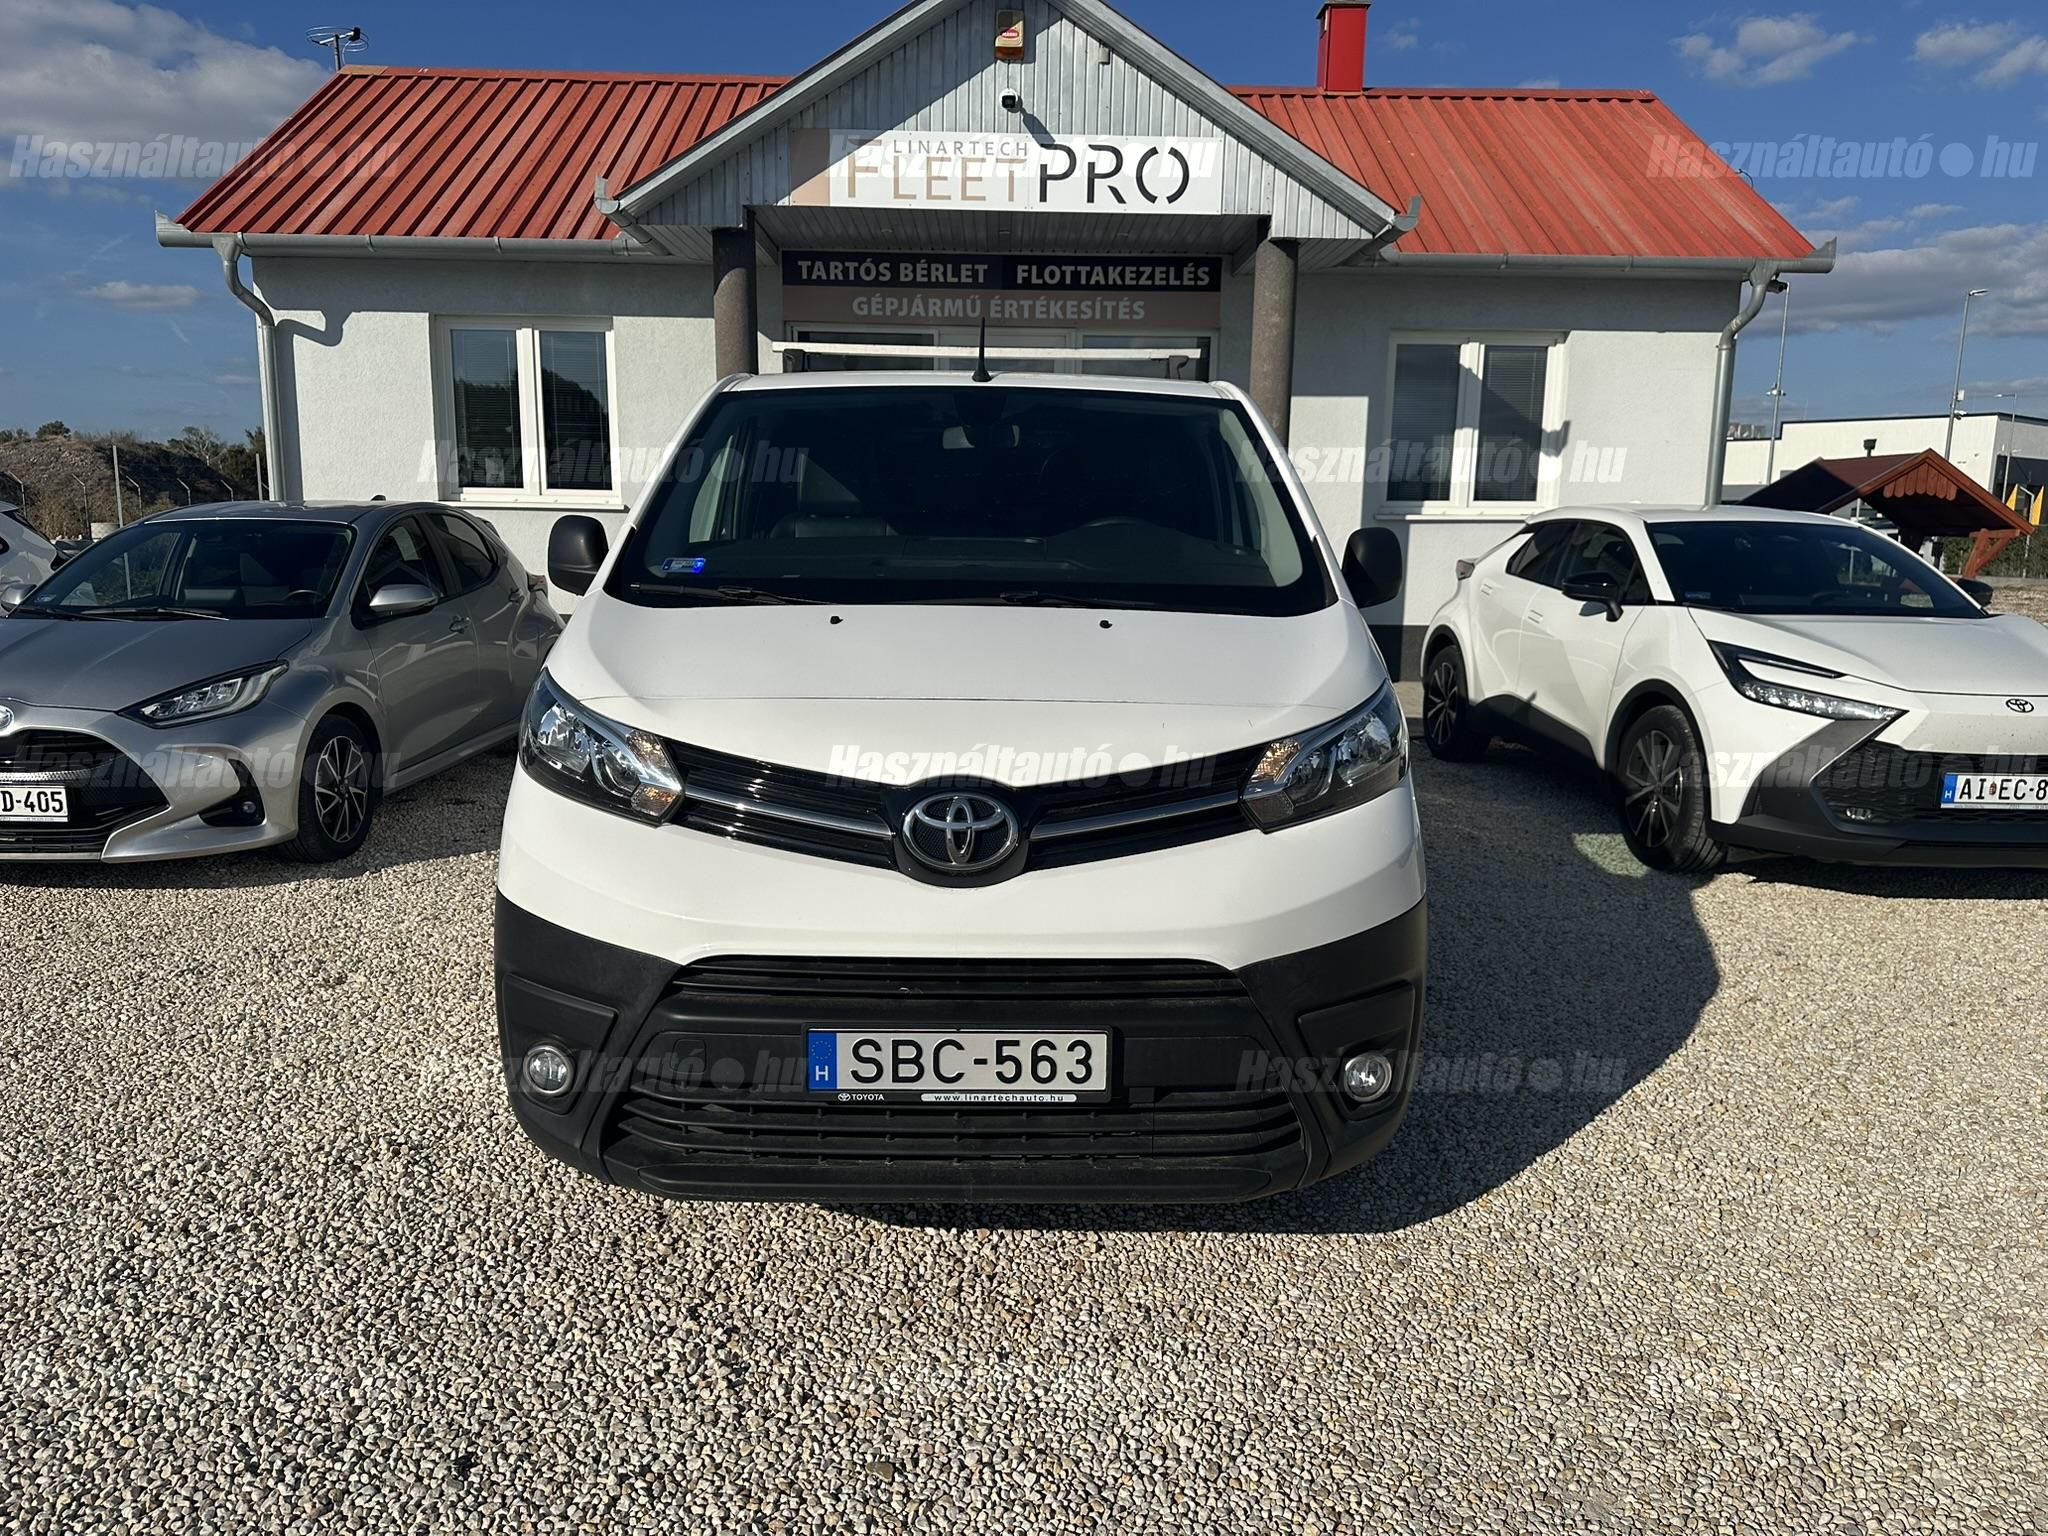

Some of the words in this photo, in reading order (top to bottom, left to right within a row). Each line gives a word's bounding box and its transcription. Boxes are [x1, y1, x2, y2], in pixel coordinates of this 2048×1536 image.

[893, 139, 1028, 156] LINARTECH
[798, 258, 892, 281] TARTÓS
[900, 260, 989, 283] BÉRLET
[1016, 263, 1210, 286] FLOTTAKEZELÉS
[852, 293, 981, 318] GÉPJÁRMŰ
[989, 296, 1145, 320] ÉRTÉKESÍTÉS
[815, 1065, 829, 1081] H
[850, 1038, 1092, 1084] SBC-563
[851, 1093, 885, 1101] TOYOTA
[934, 1093, 1064, 1102] www.linartechauto.hu
